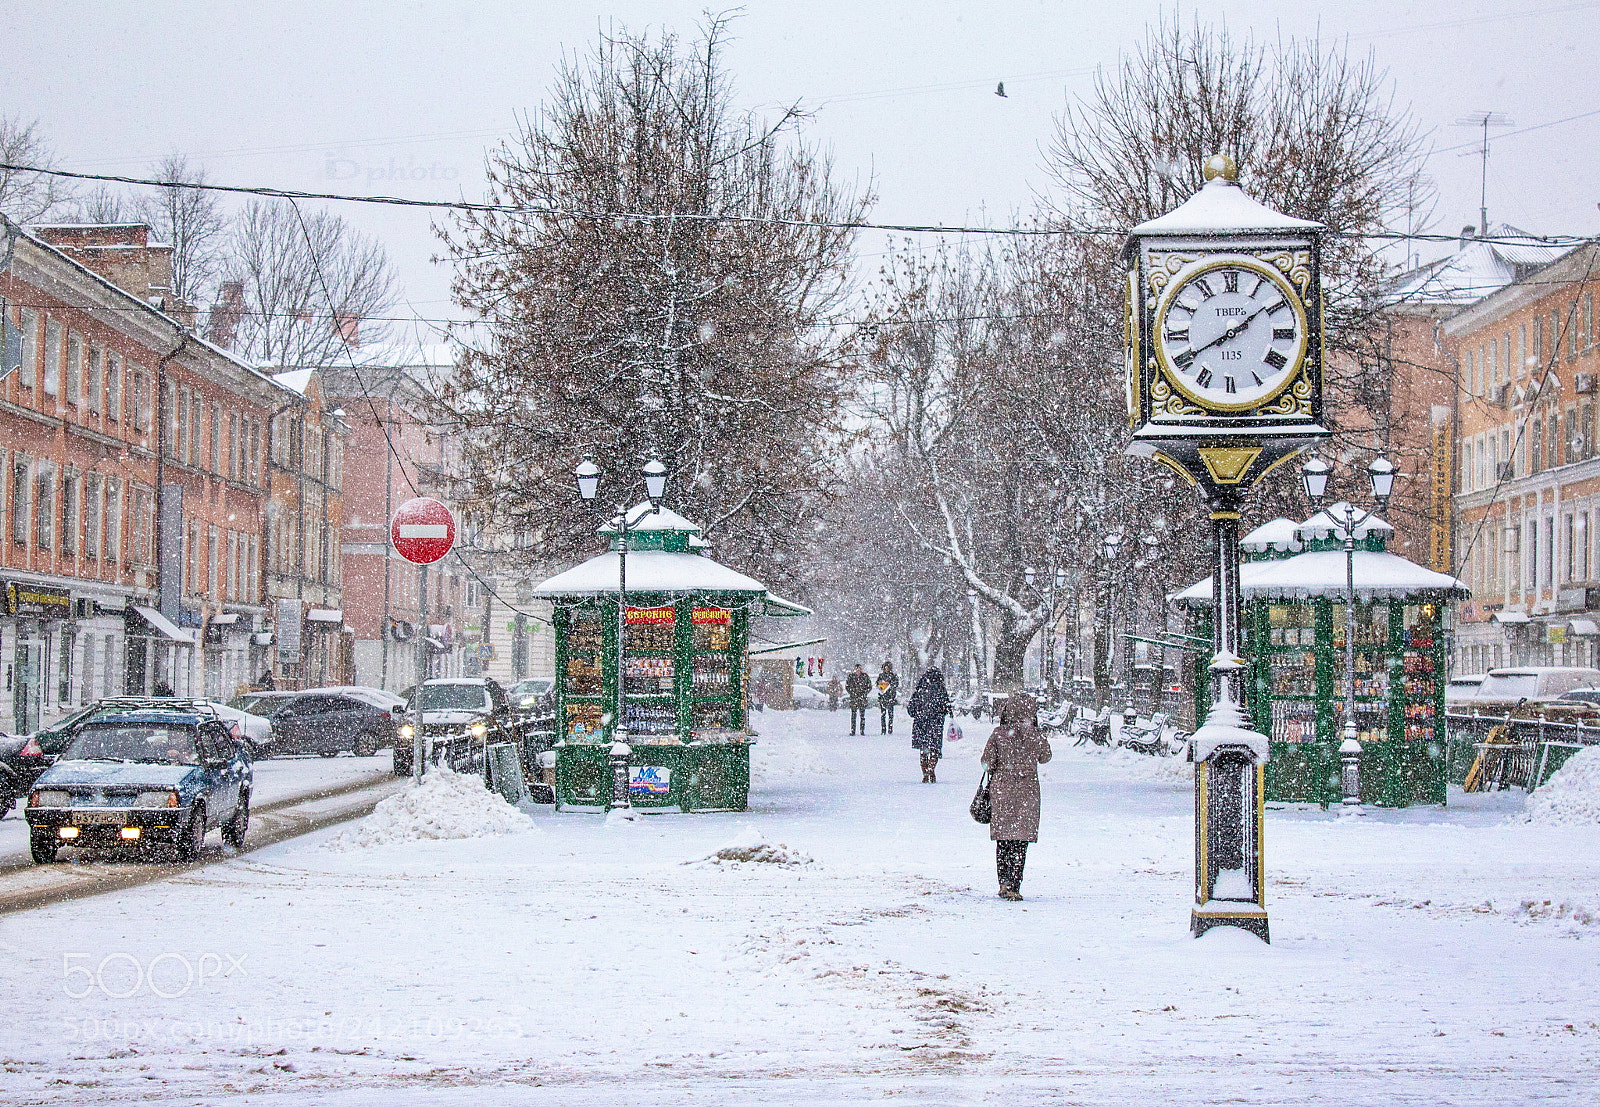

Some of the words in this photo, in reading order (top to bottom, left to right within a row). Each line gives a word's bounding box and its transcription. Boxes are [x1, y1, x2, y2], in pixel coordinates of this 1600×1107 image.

[1215, 307, 1247, 316] ТВЕРЬ
[1221, 350, 1242, 361] 1135
[627, 610, 673, 620] ВЕРСКИЕ
